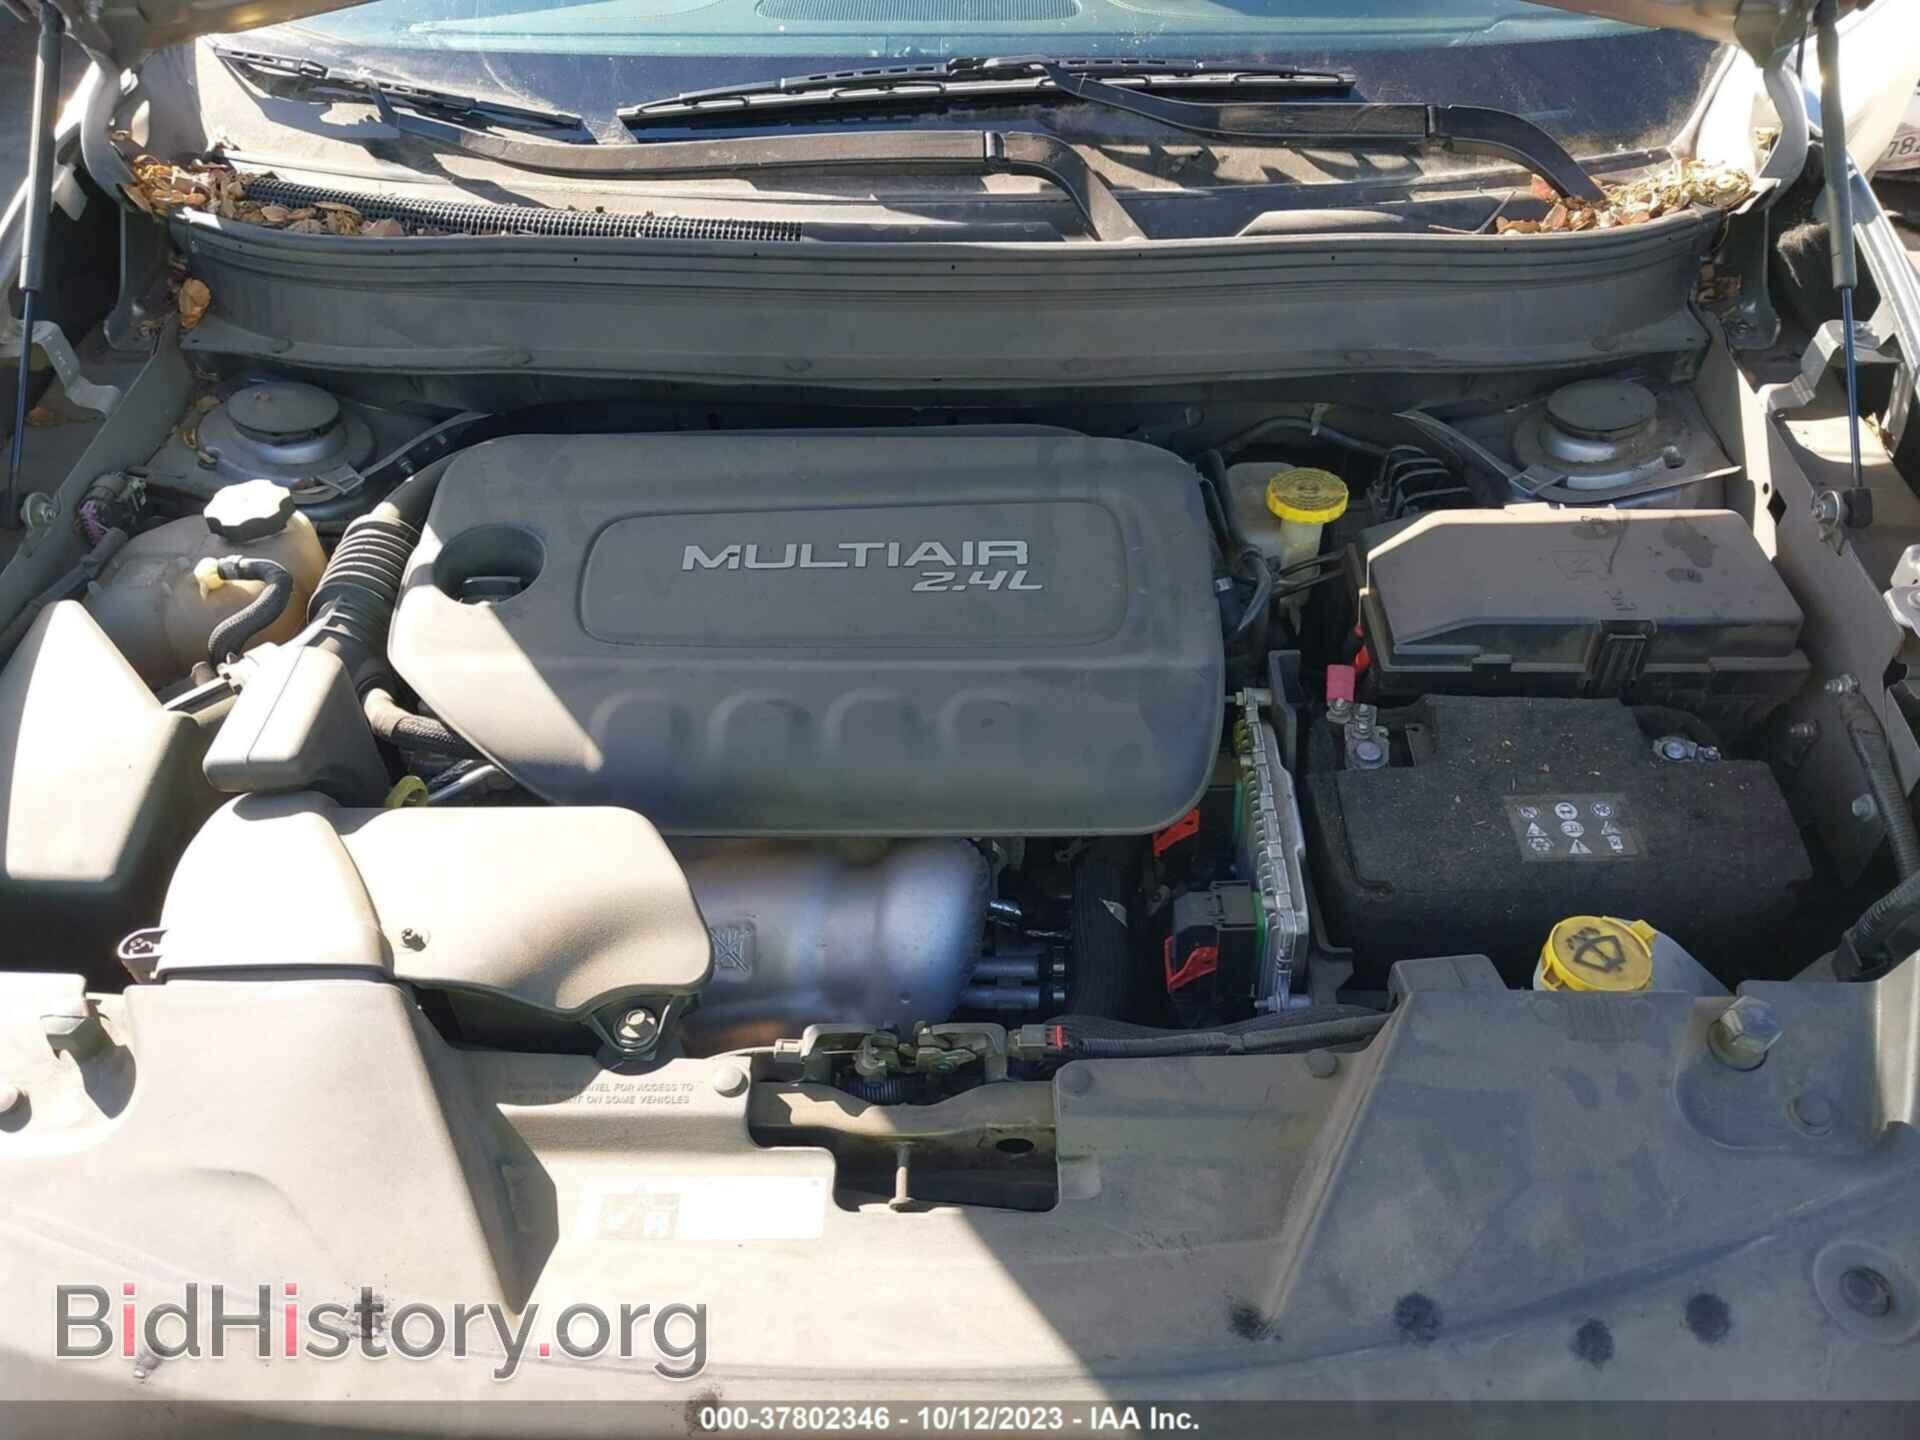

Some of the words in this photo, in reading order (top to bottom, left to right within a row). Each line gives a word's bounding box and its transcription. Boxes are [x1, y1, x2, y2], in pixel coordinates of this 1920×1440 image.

[682, 540, 1030, 571] MULTIAIR
[911, 570, 1044, 593] 2.4L
[614, 1083, 635, 1093] FOR
[636, 1082, 678, 1093] ACCESS
[681, 1082, 695, 1093] TO
[605, 1095, 636, 1105] SOME
[640, 1095, 690, 1105] VEHICLES
